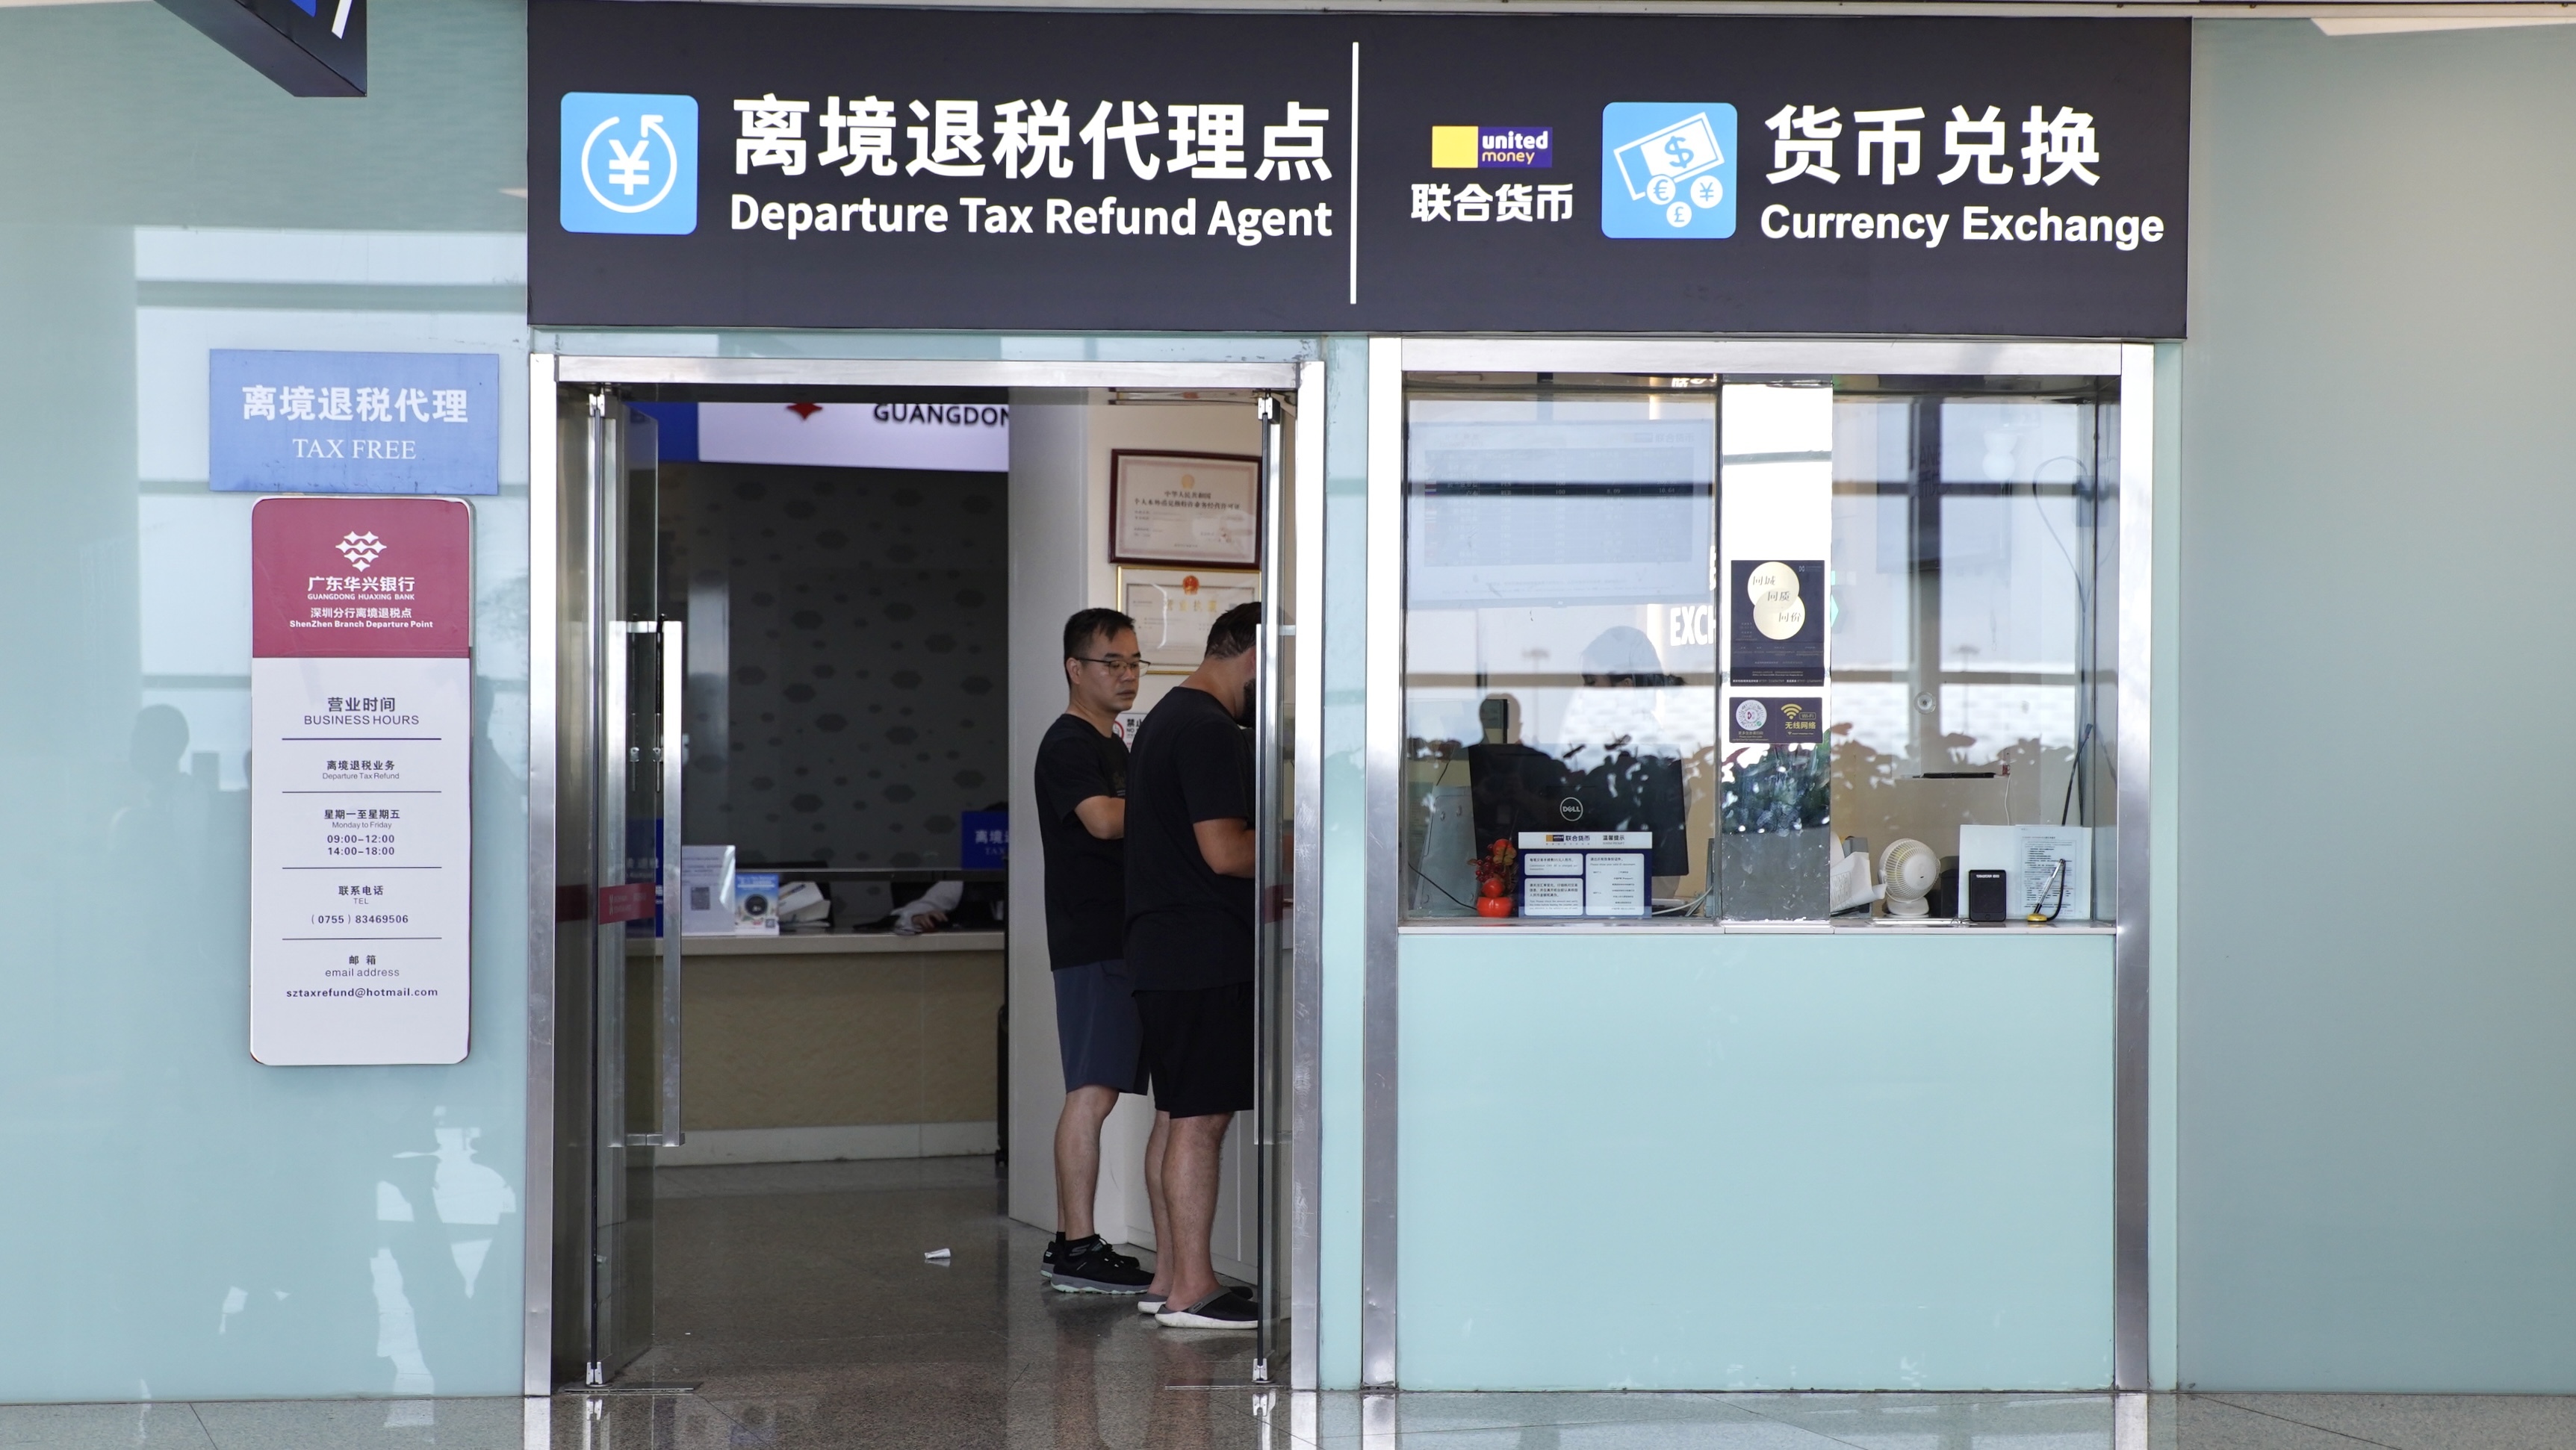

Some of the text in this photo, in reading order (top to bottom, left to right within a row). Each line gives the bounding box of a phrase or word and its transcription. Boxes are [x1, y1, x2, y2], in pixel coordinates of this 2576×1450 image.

[733, 93, 1332, 181] 离境退税代理点
[1483, 131, 1548, 149] united
[1765, 105, 2099, 186] 货币兑换
[1483, 152, 1535, 164] money
[1411, 184, 1573, 222] 联合货币
[732, 194, 1332, 246] Departure Tax Refund Agent
[1761, 205, 2164, 251] Currency Exchange
[243, 385, 468, 423] 离境退税代理
[293, 439, 416, 459] TAX FREE
[308, 576, 415, 591] 广东华兴银行
[1768, 591, 1790, 601] 同质
[311, 608, 412, 618] 深圳分行离境退税点
[1779, 612, 1801, 622] 同价
[366, 620, 409, 629] Departure
[328, 697, 394, 712] 营业时间
[305, 715, 419, 724] BUSINESS HOURS
[327, 760, 394, 771] 离境退税业务
[325, 809, 400, 819] 星期一至星期五
[370, 821, 392, 830] Friday
[327, 835, 394, 843] 09:00-12:00
[329, 847, 394, 855] 14:00-18:00
[338, 886, 383, 895] 联系电话
[356, 915, 408, 923] 83469506
[326, 968, 399, 977] email address
[287, 988, 437, 998] sztaxrefund@hotmail.com
